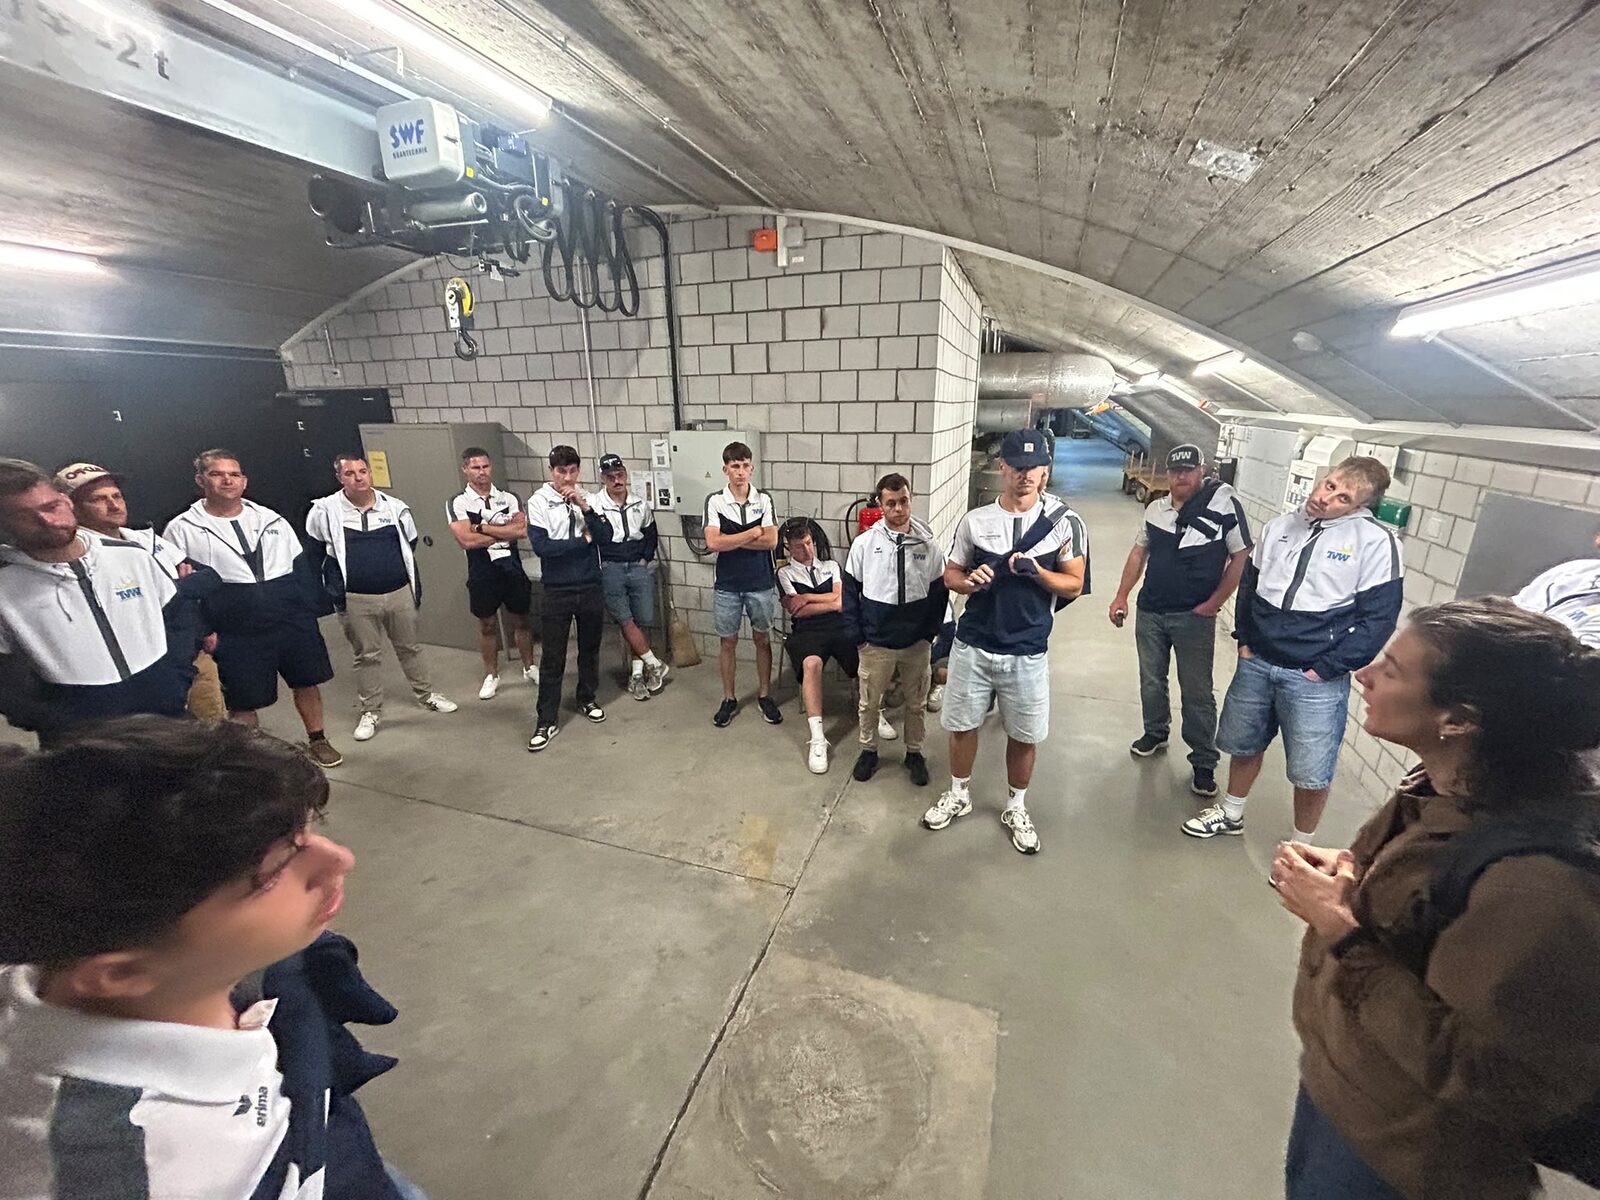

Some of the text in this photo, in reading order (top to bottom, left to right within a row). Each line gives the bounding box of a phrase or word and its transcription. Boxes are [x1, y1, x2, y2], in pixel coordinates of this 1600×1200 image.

[390, 118, 424, 149] SWF
[1171, 451, 1192, 462] TVW
[255, 1086, 268, 1127] erima
